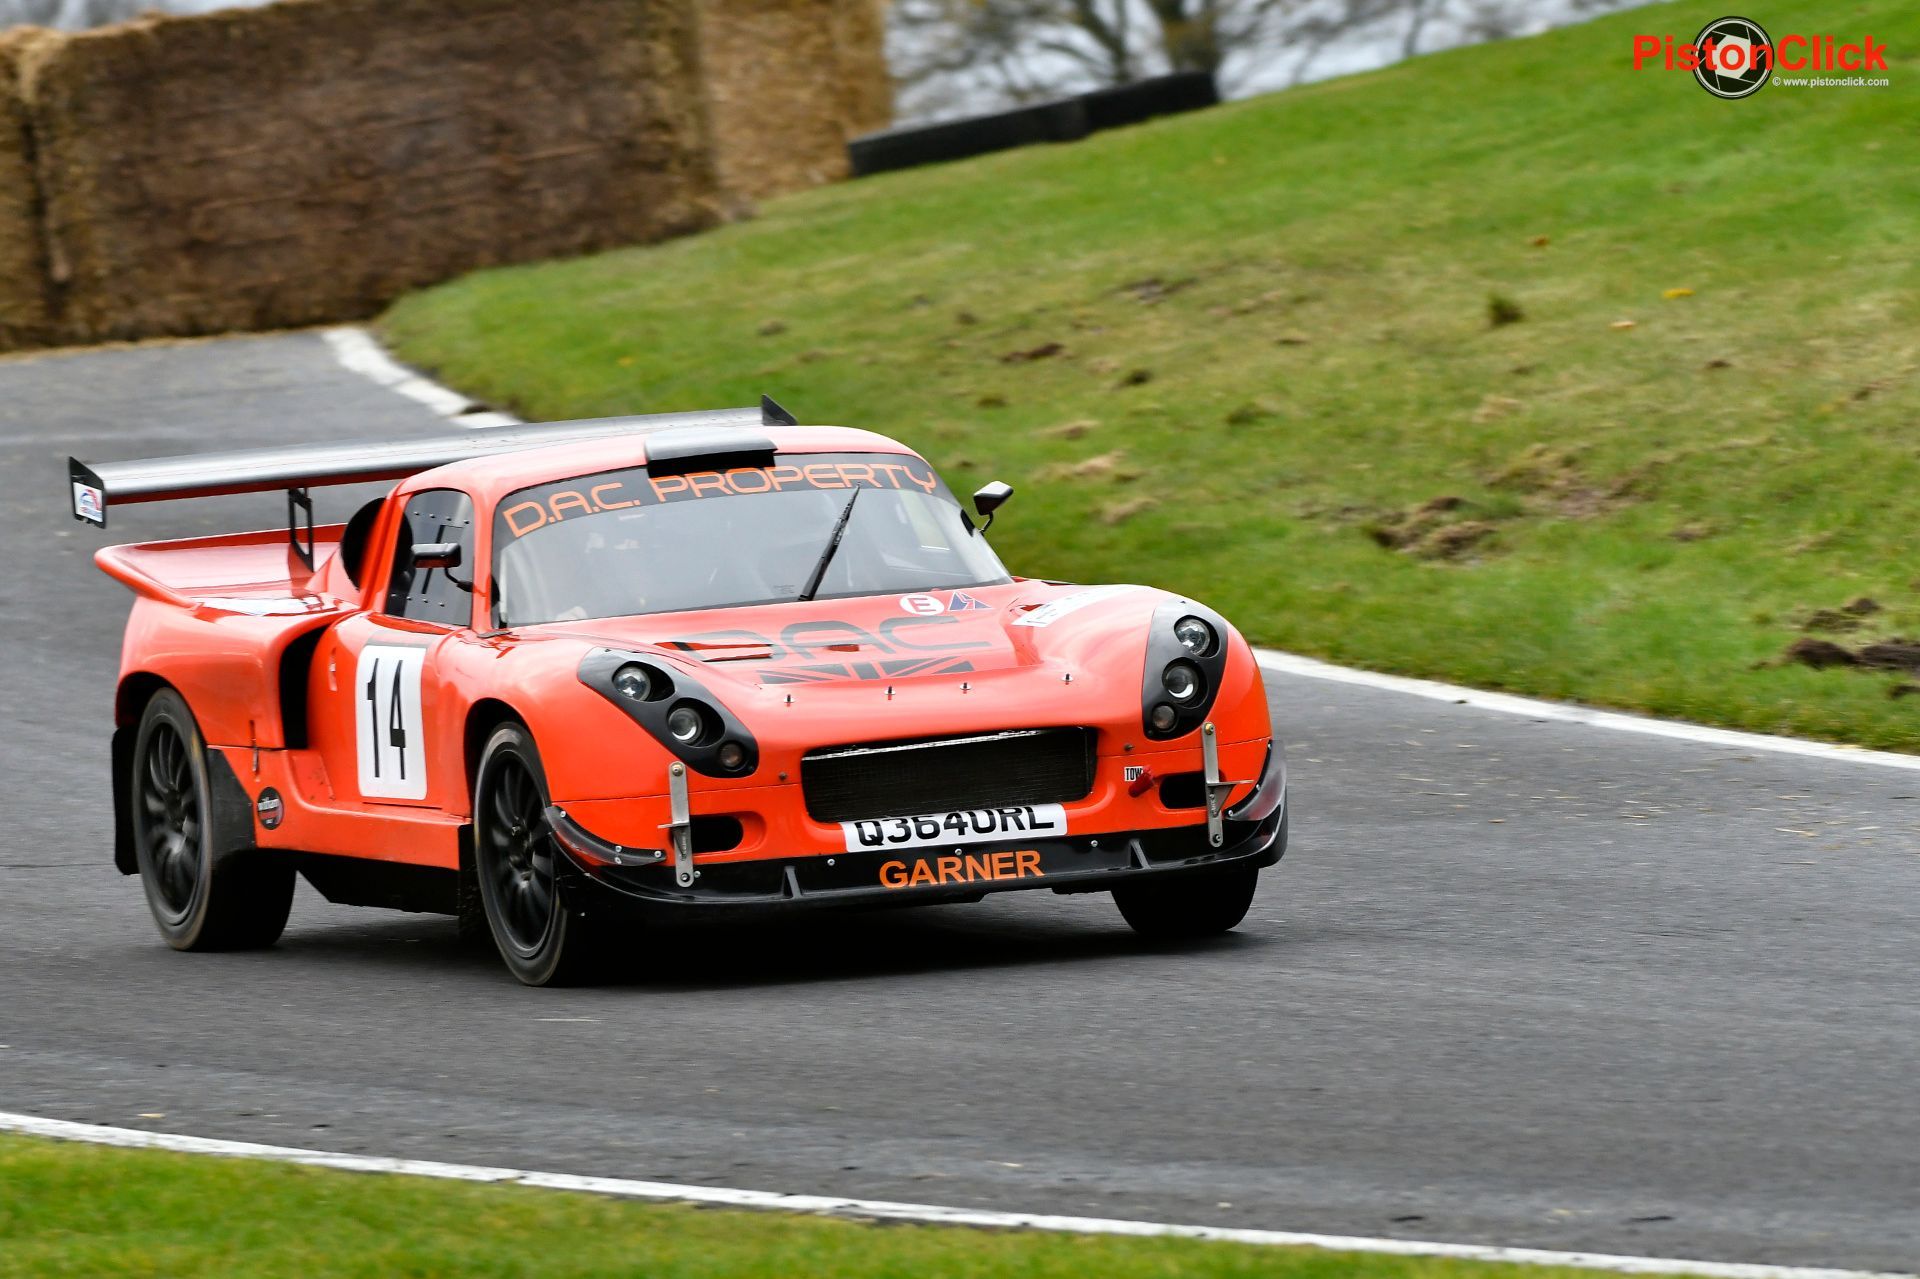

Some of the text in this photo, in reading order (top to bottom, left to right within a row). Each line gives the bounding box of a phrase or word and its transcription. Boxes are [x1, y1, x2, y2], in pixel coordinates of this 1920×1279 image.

[503, 463, 936, 539] D.A.C. PROPERTY
[367, 658, 406, 780] 14
[879, 850, 1045, 888] GARNER
